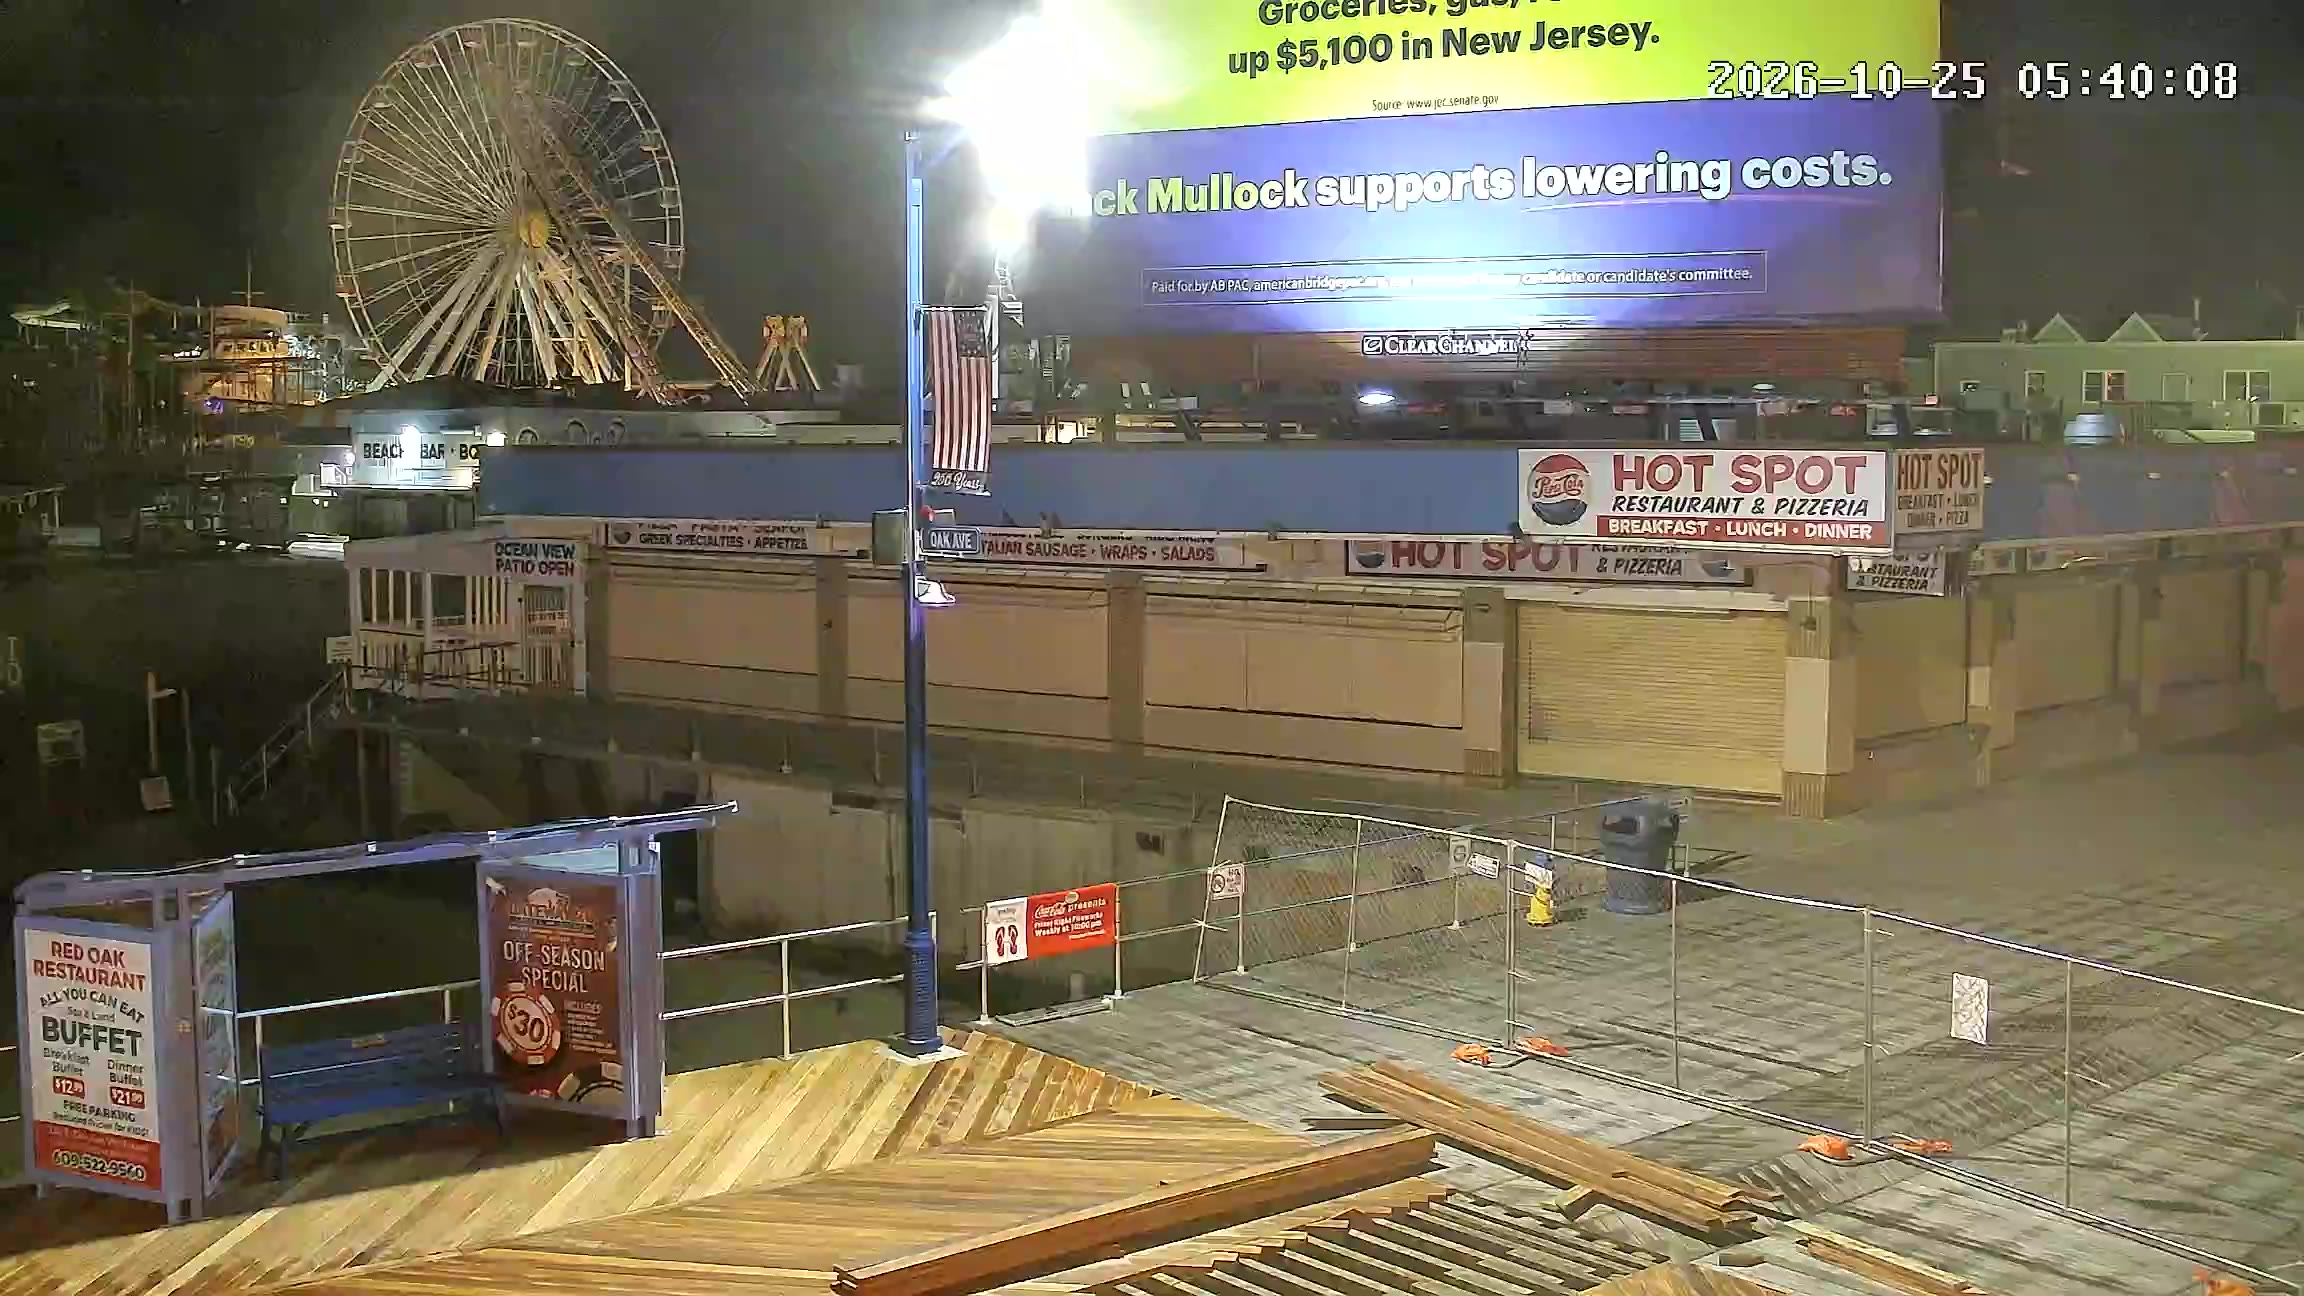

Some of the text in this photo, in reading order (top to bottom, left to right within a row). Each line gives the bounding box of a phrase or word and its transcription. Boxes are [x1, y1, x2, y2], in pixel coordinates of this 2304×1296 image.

[1229, 20, 1660, 79] up $5,100 in New Jersey.
[1147, 168, 1309, 213] Mullock
[1315, 164, 1516, 212] supports
[1522, 150, 1731, 200] lowering
[1741, 150, 1892, 189] costs.
[1152, 280, 1175, 293] Paid
[1195, 280, 1209, 295] by
[1587, 271, 1602, 282] or
[1679, 266, 1752, 281] committee.
[1612, 454, 1867, 495] HOT SPOT
[1897, 453, 1981, 491] HOT SPOT
[1611, 495, 1868, 517] RESTAURANT & PIZZERIA
[930, 531, 972, 549] OAK AVE
[1608, 518, 1873, 540] BREAKFAST LUNCH DINNER
[496, 543, 576, 559] OCEAN VIEW
[983, 540, 1215, 561] TALIAN SAUSAGE WRAPS SALADS
[496, 559, 575, 576] PATIO OPEN
[1596, 558, 1682, 576] & PIZZERIA
[1858, 563, 1938, 578] STAURANT
[1872, 576, 1929, 590] PIZZERIA
[51, 941, 125, 968] RED OAK
[34, 959, 146, 992] RESTAURANT
[521, 966, 588, 993] SPECIAL
[40, 988, 145, 1023] ALL YOU CAN EAT
[42, 1016, 142, 1056] BUFFET
[508, 1003, 545, 1042] $30
[64, 1100, 136, 1122] FREE PARKING
